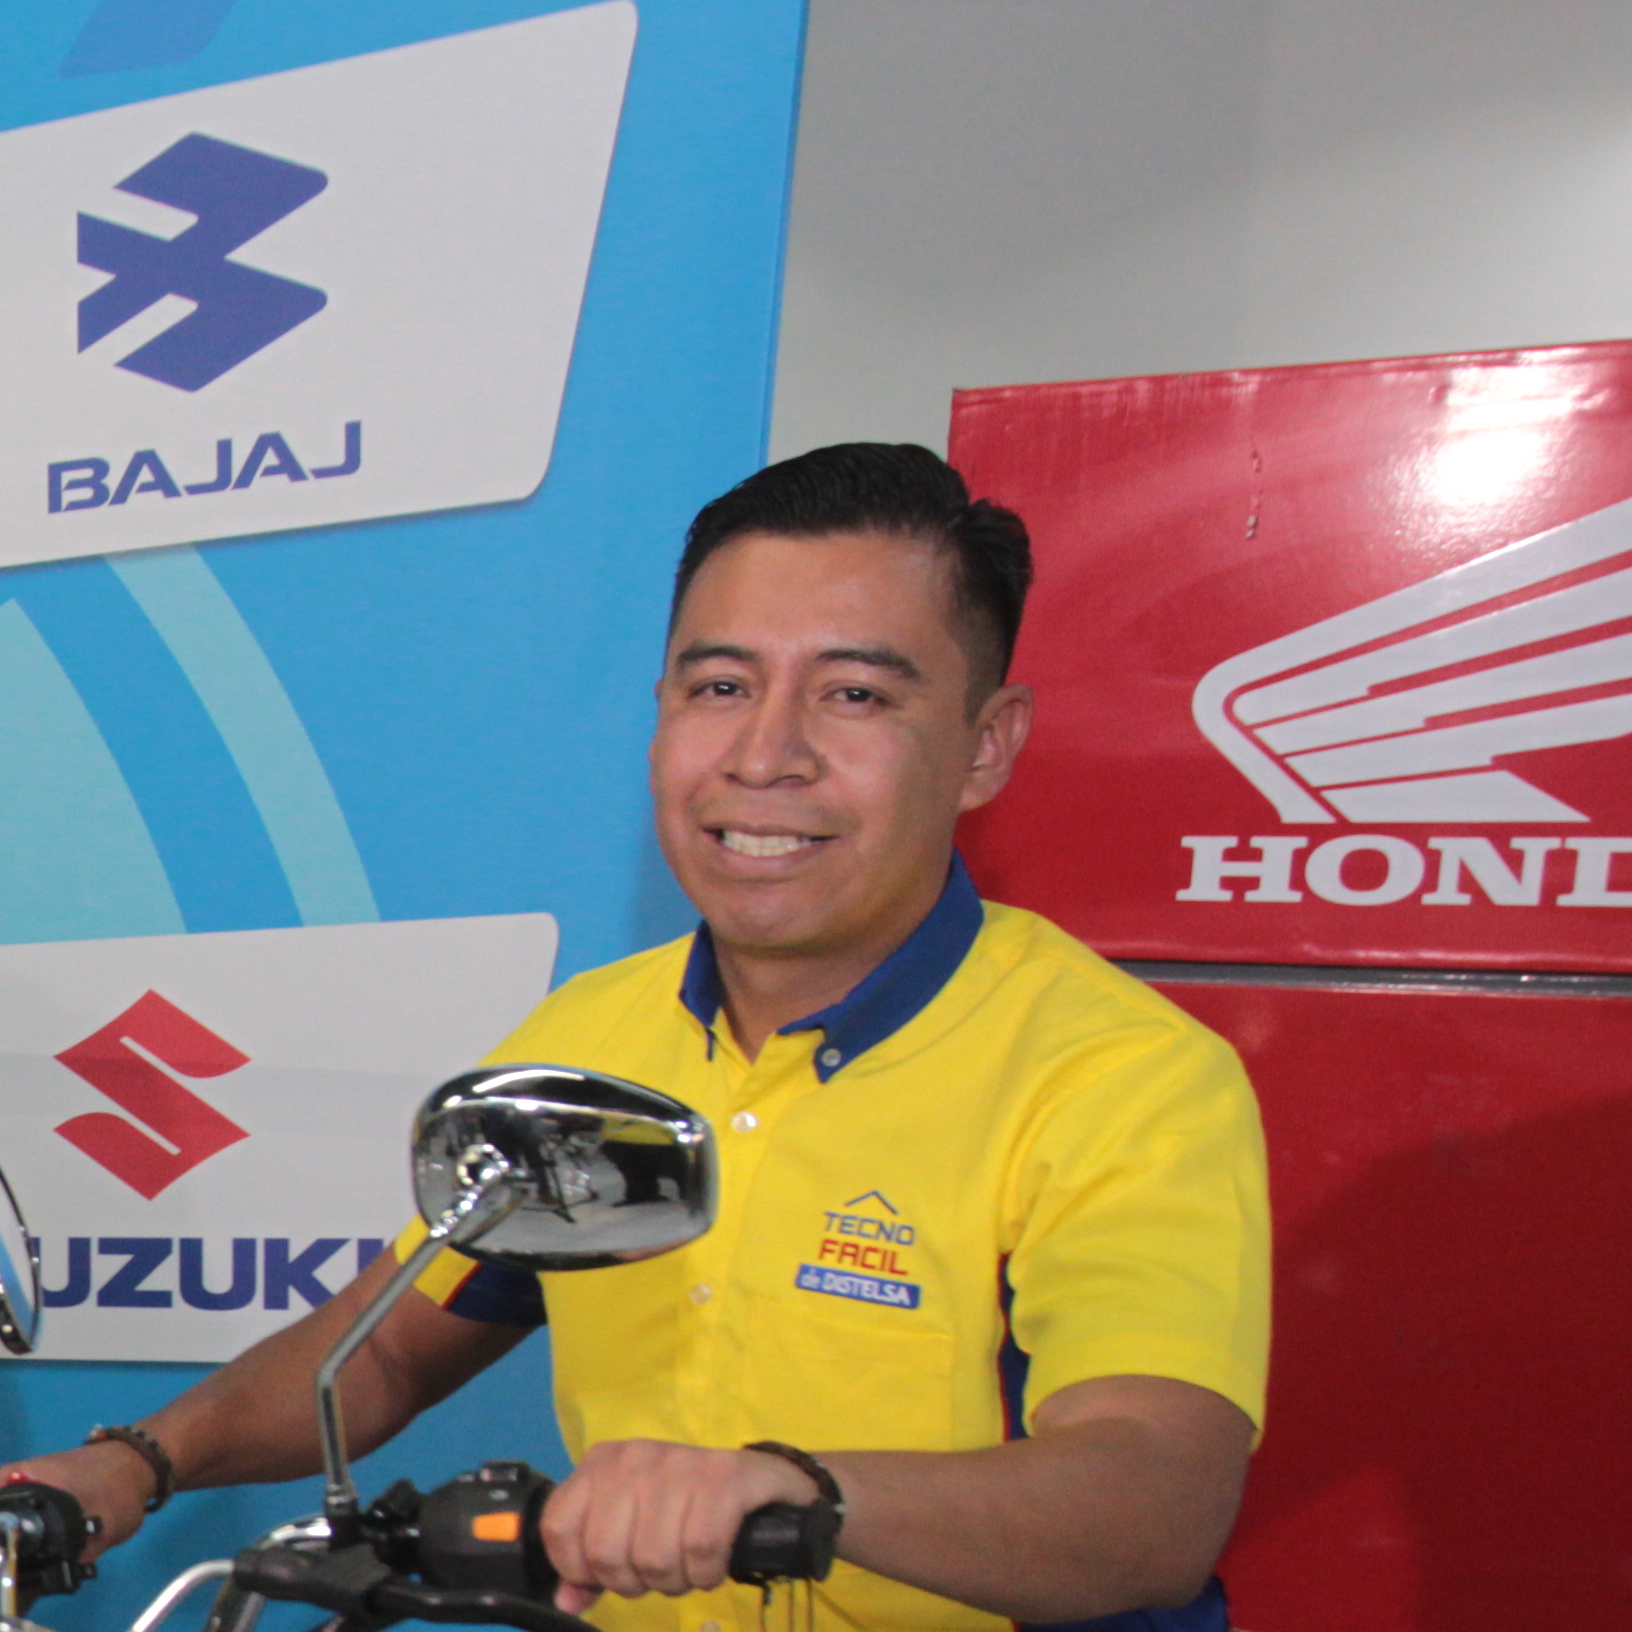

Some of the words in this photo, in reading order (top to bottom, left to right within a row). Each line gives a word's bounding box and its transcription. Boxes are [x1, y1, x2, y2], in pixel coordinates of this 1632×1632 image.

[47, 420, 362, 514] BAJAJ
[824, 1211, 915, 1245] TECNO
[817, 1239, 908, 1276] FACIL
[822, 1271, 912, 1306] DISTELSA
